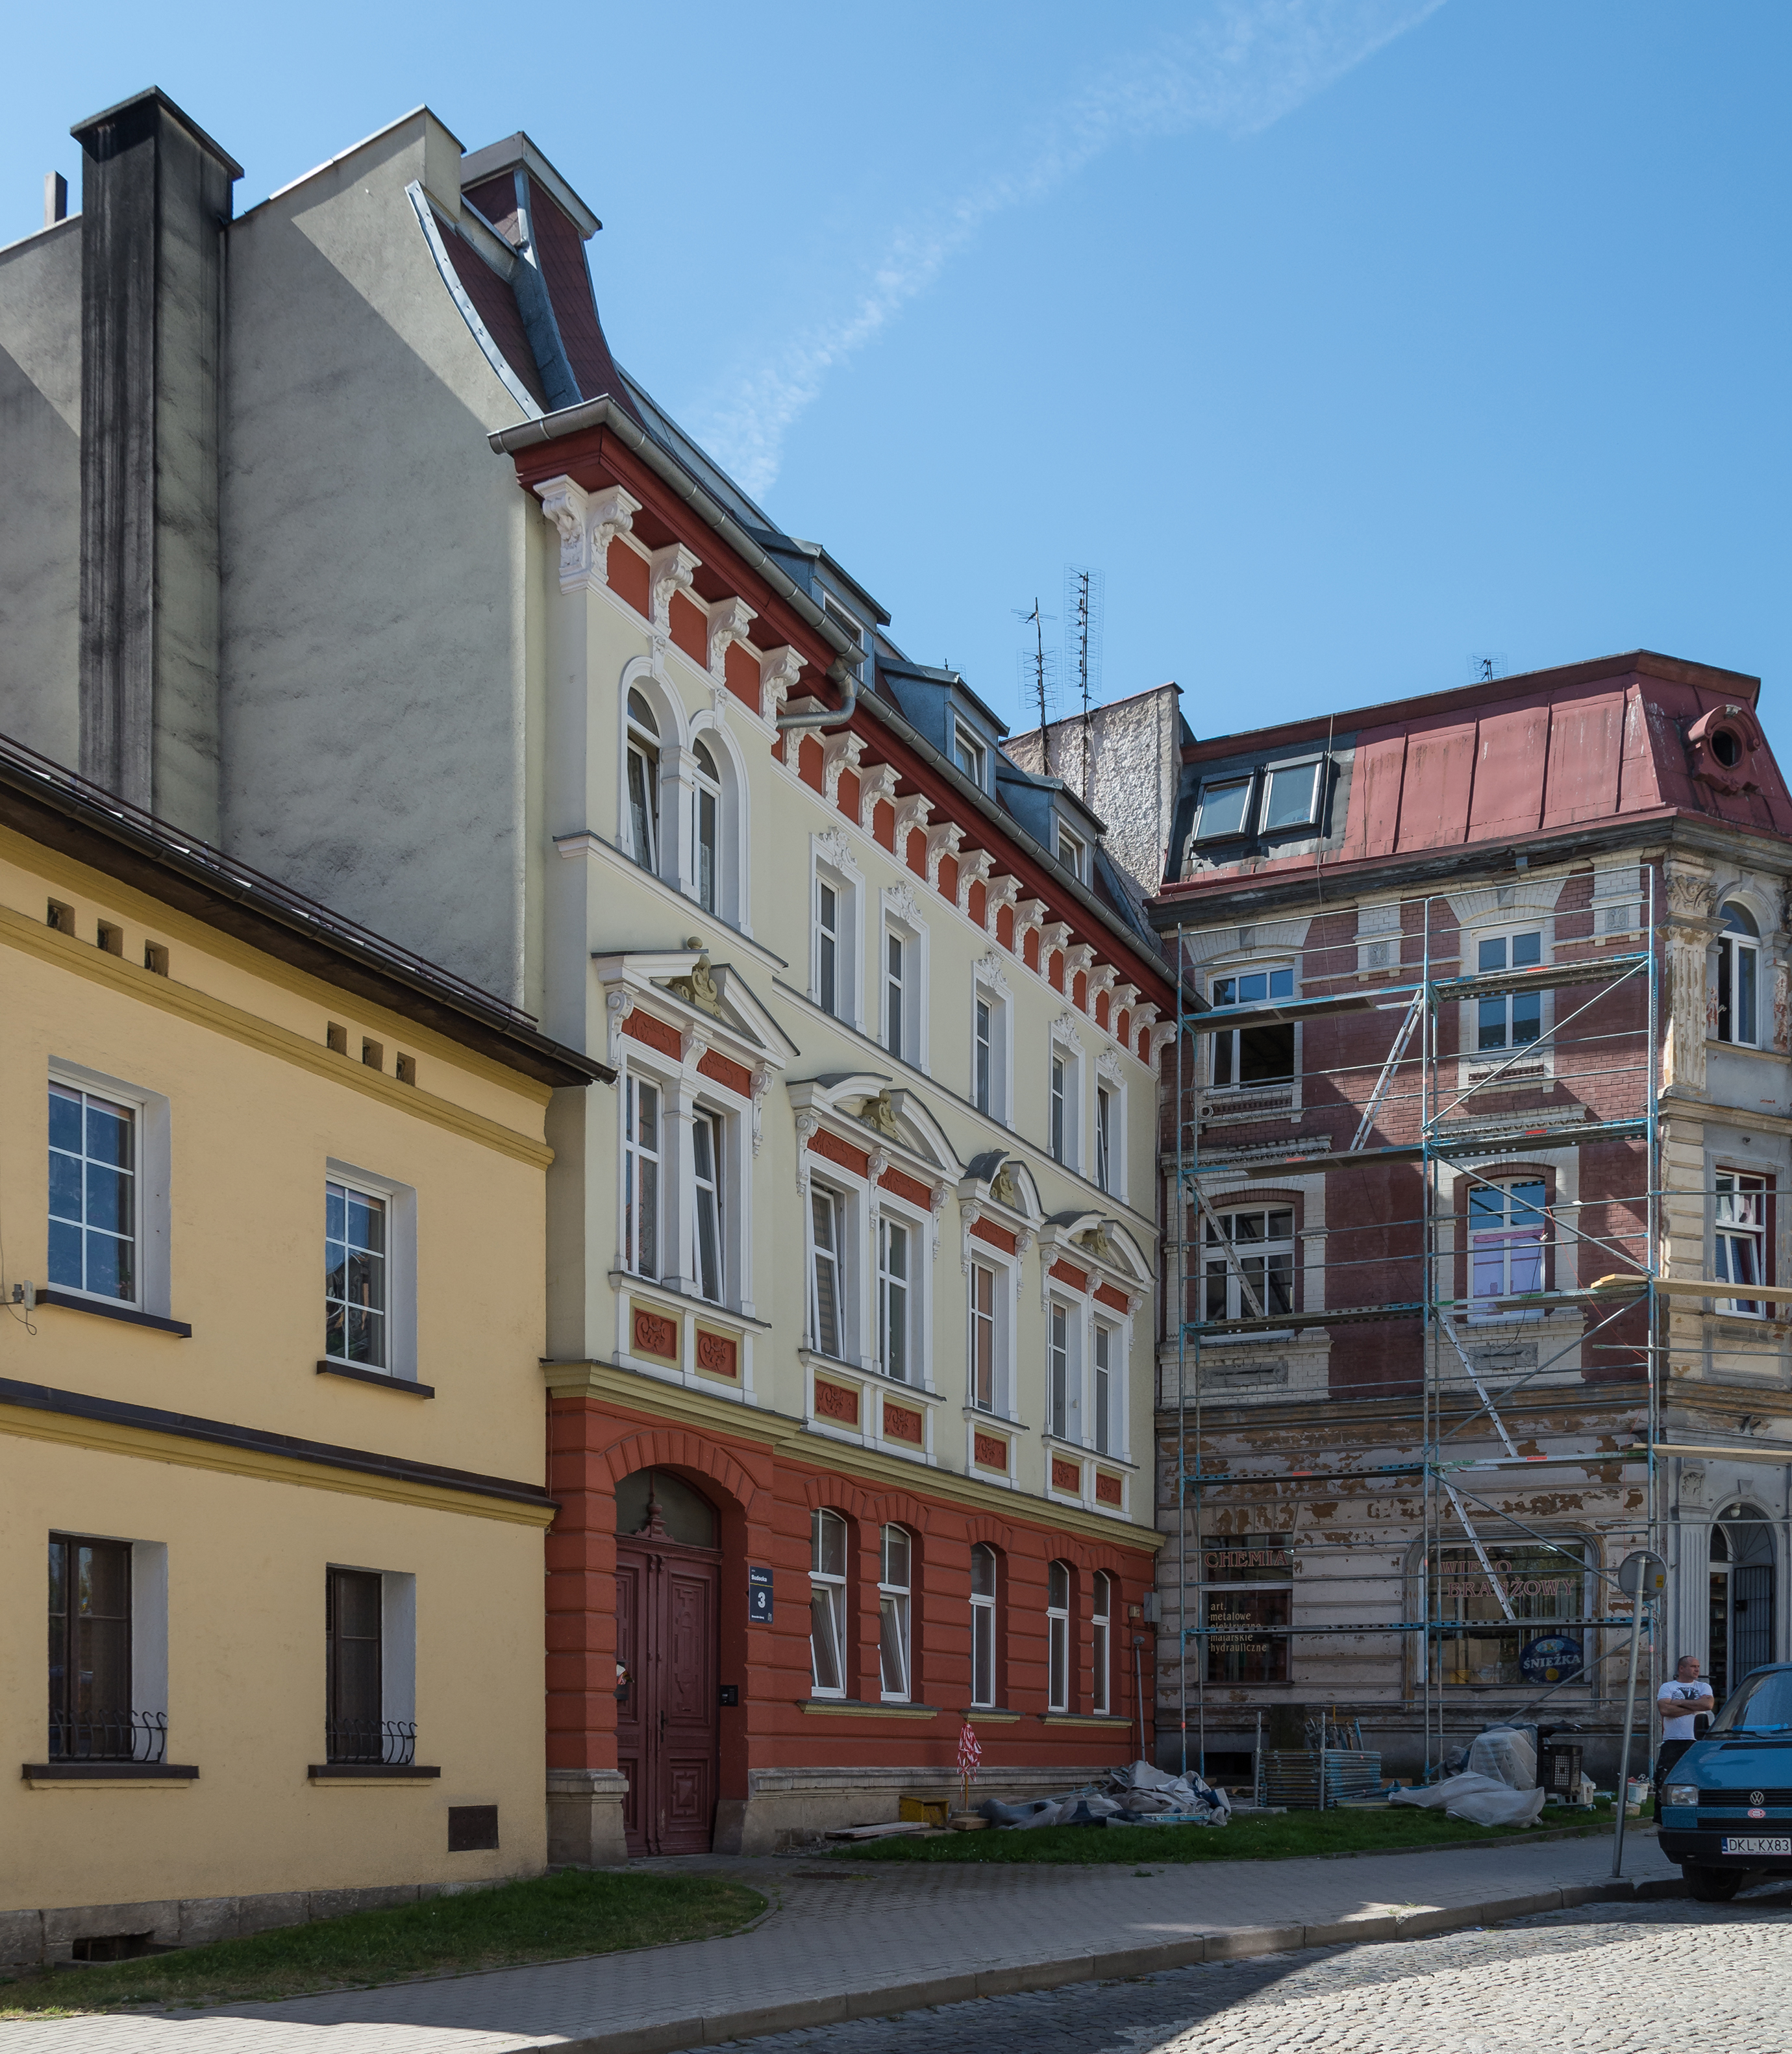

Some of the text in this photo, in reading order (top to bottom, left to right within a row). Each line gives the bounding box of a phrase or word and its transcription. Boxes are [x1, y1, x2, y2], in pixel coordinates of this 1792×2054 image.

[1204, 1551, 1288, 1567] CHEMIA
[1440, 1560, 1512, 1576] WIEO
[758, 1592, 765, 1608] 3
[1210, 1602, 1226, 1610] art.
[1523, 1653, 1581, 1670] ŚNIEŻKA
